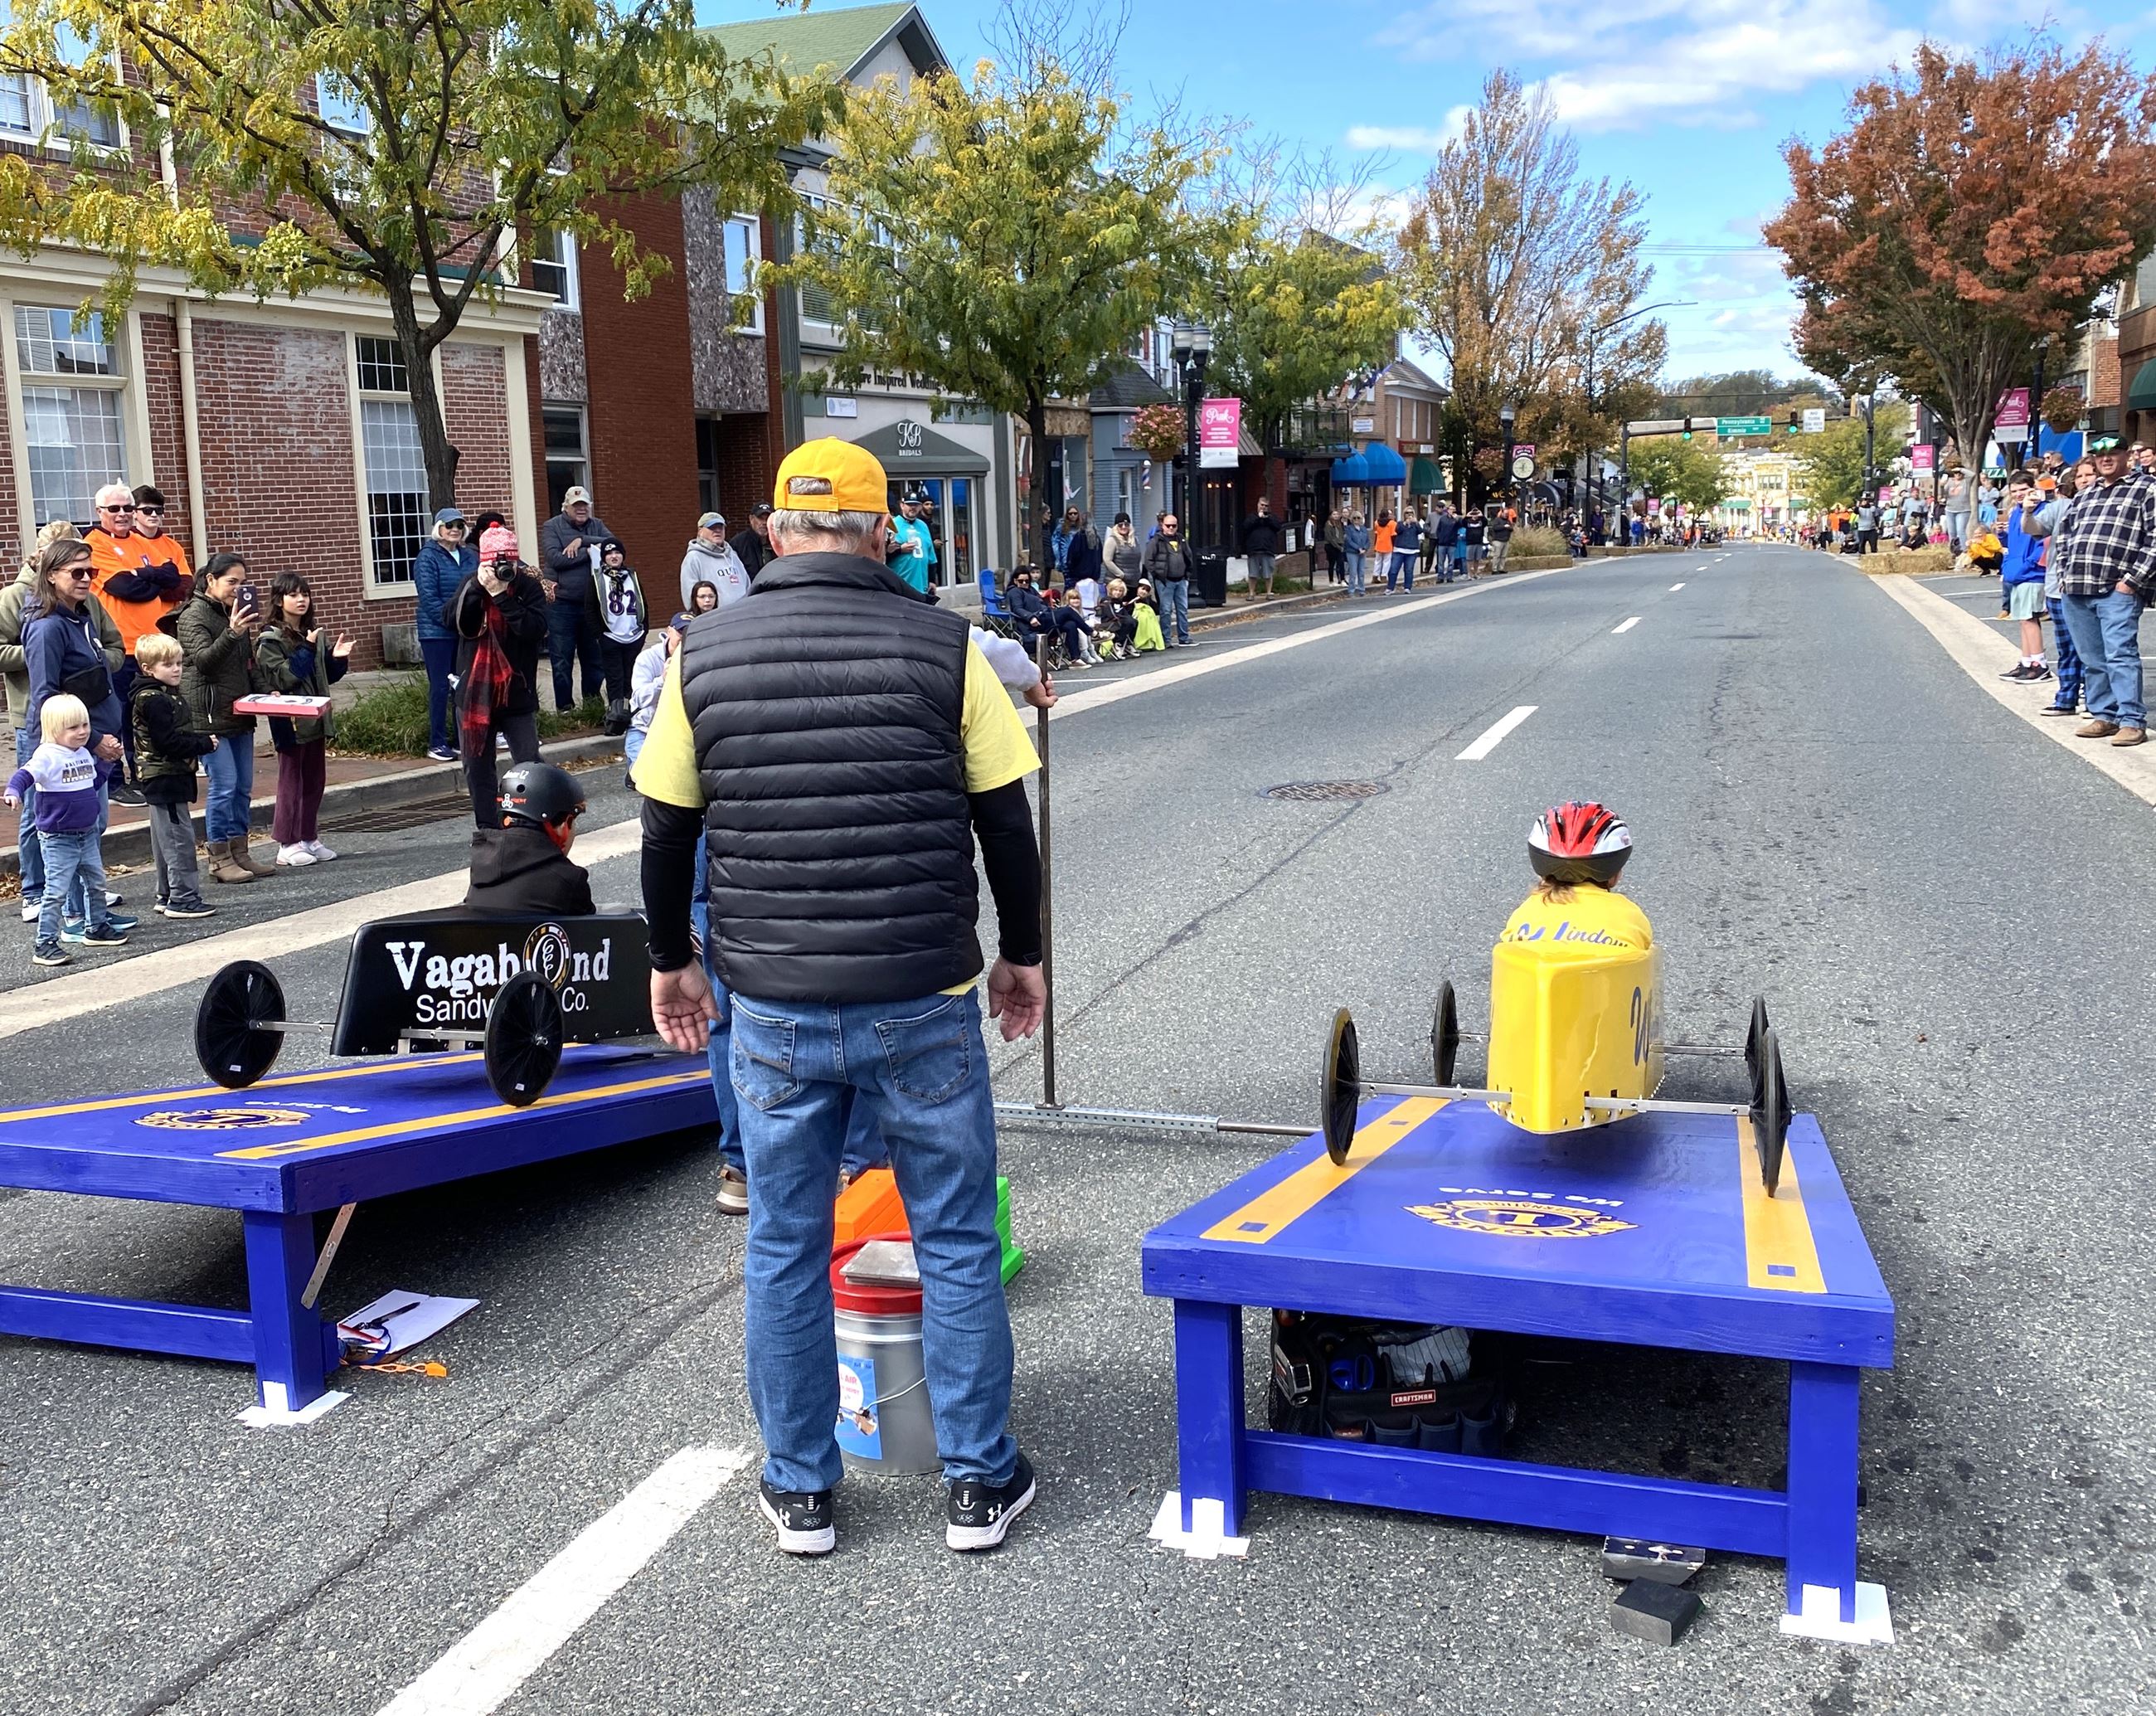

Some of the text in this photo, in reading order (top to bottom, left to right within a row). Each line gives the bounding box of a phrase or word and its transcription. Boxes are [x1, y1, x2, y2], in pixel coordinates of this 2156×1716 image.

[608, 590, 637, 615] 82
[561, 986, 590, 1012] Co.
[1439, 1187, 1624, 1207] We Serve
[1442, 1220, 1580, 1237] LIONS
[1394, 1393, 1433, 1404] CRAFTSMAN
